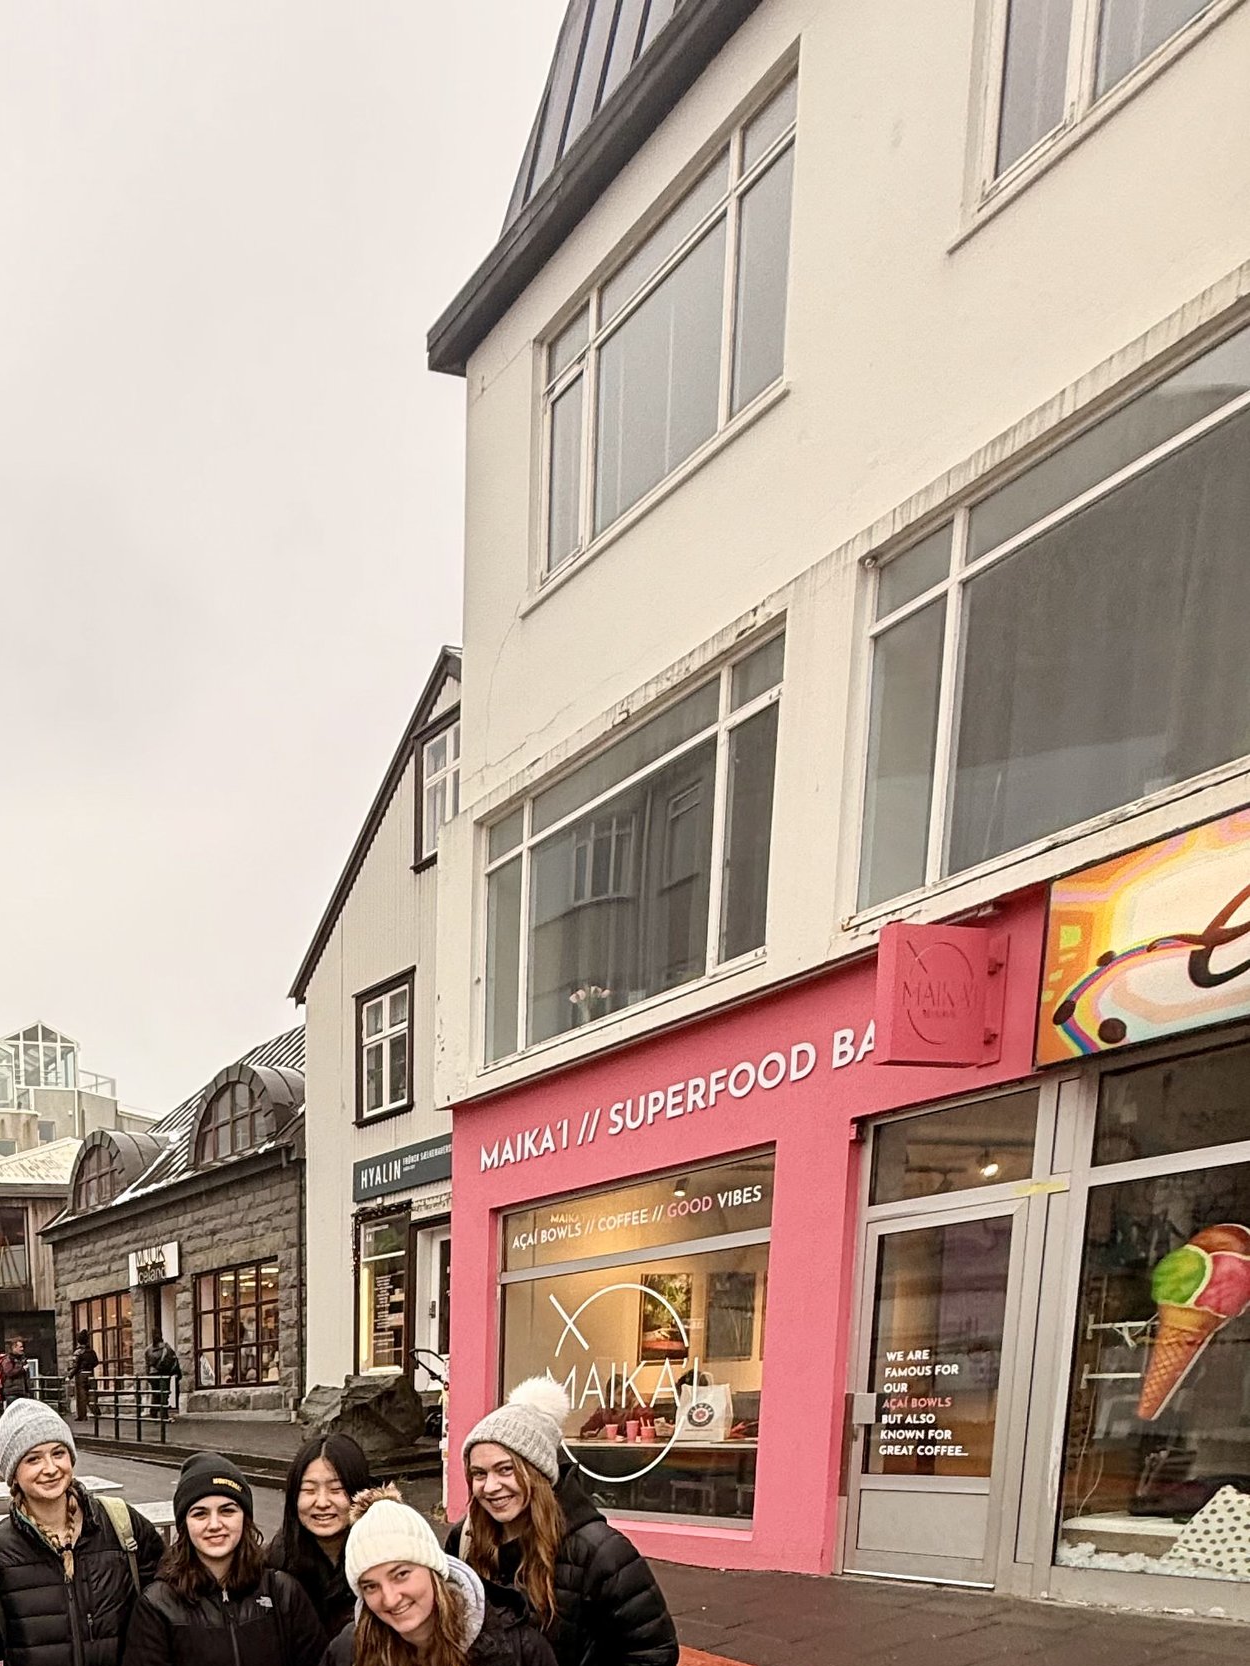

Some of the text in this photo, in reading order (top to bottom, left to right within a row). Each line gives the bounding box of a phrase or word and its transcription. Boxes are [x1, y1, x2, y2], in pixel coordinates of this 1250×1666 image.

[479, 1119, 568, 1172] MAIKA'I
[607, 1041, 817, 1136] SUPERFOOD
[832, 1019, 876, 1070] BA
[360, 1158, 401, 1190] HYALIN
[540, 1222, 582, 1244] BOWLS
[597, 1208, 649, 1233] COFFEE
[666, 1195, 713, 1218] GOOD
[716, 1184, 763, 1209] VIBES
[886, 1349, 930, 1361] WE ARE
[884, 1364, 959, 1378] FAMOUS FOR
[883, 1382, 908, 1393] OUR
[911, 1397, 952, 1408] BOWLS
[881, 1413, 936, 1424] BUT ALSO
[880, 1429, 952, 1440] KNOWN FOR
[878, 1445, 914, 1456] GREAT
